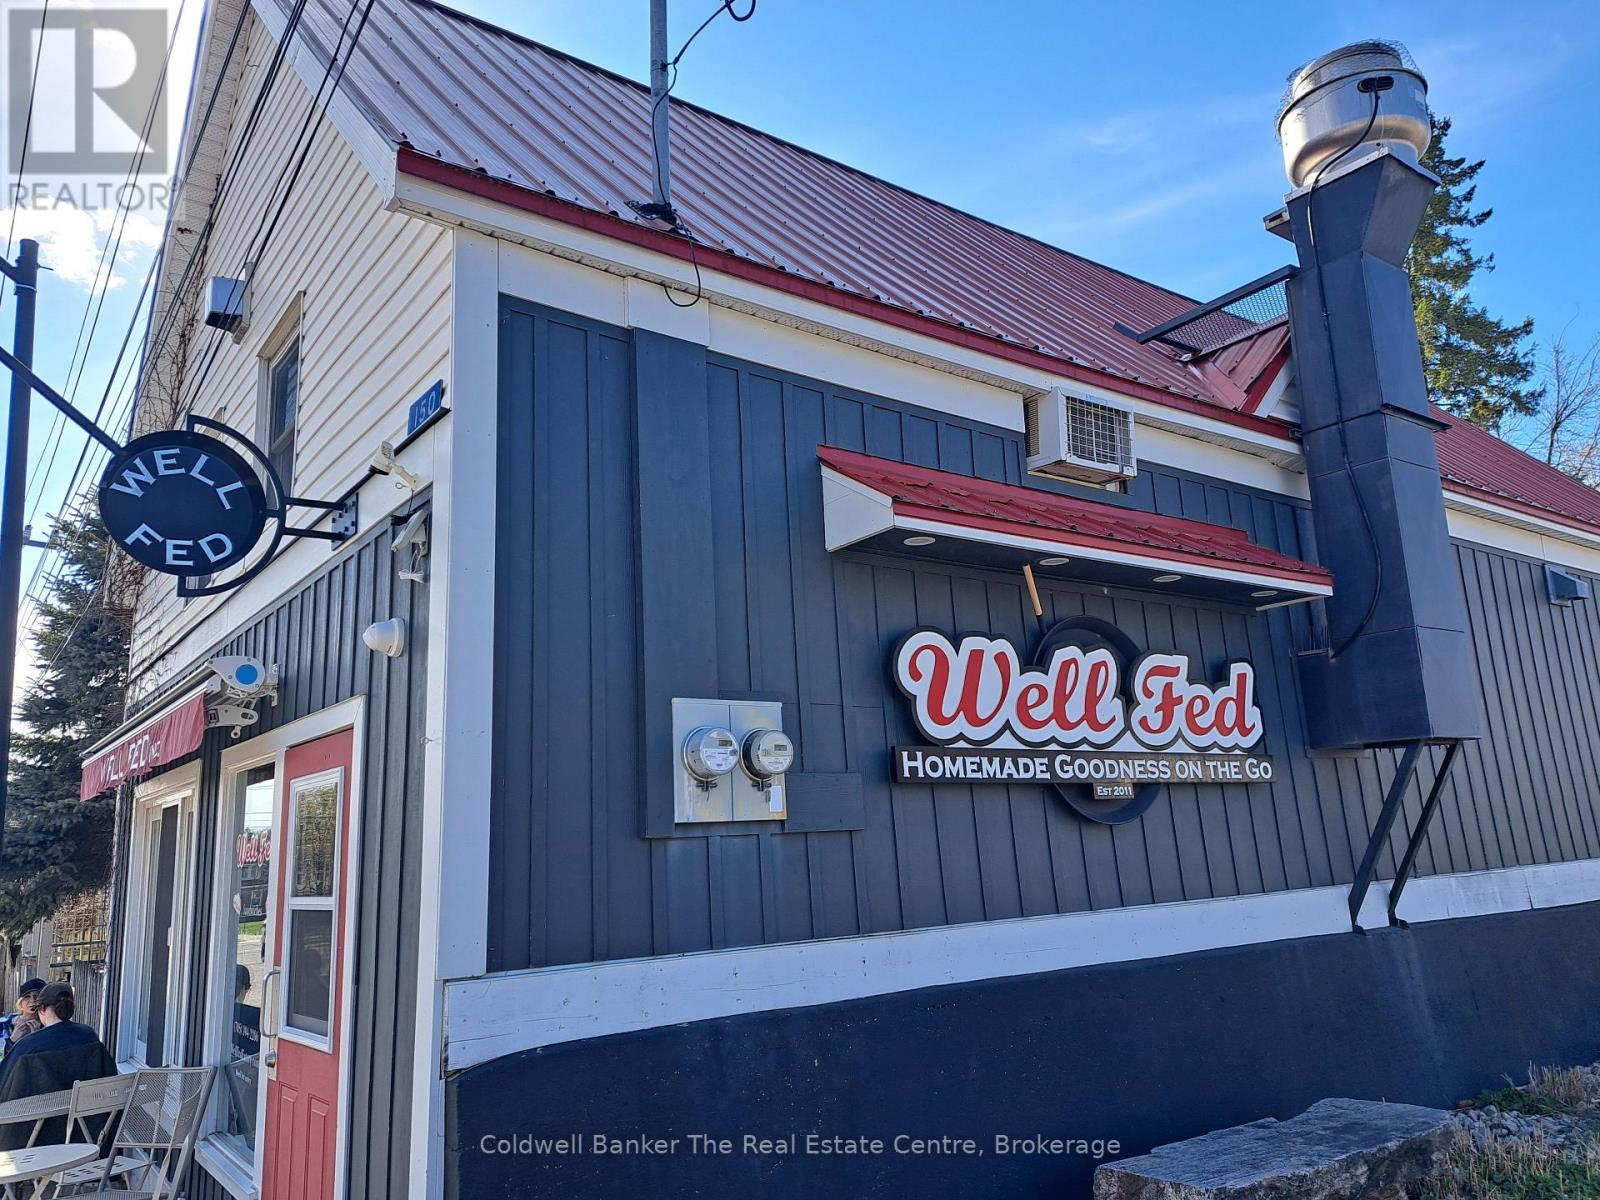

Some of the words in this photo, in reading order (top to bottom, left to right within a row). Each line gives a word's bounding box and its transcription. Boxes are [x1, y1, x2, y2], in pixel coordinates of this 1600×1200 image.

[414, 390, 436, 428] 150
[110, 448, 244, 510] WELL
[124, 523, 233, 567] FED
[905, 642, 1119, 734] Well
[1136, 663, 1257, 738] Fed
[1175, 760, 1203, 779] ON
[1205, 760, 1243, 780] THE
[1113, 786, 1133, 797] 2011
[236, 832, 258, 868] Well
[258, 831, 272, 868] Fe
